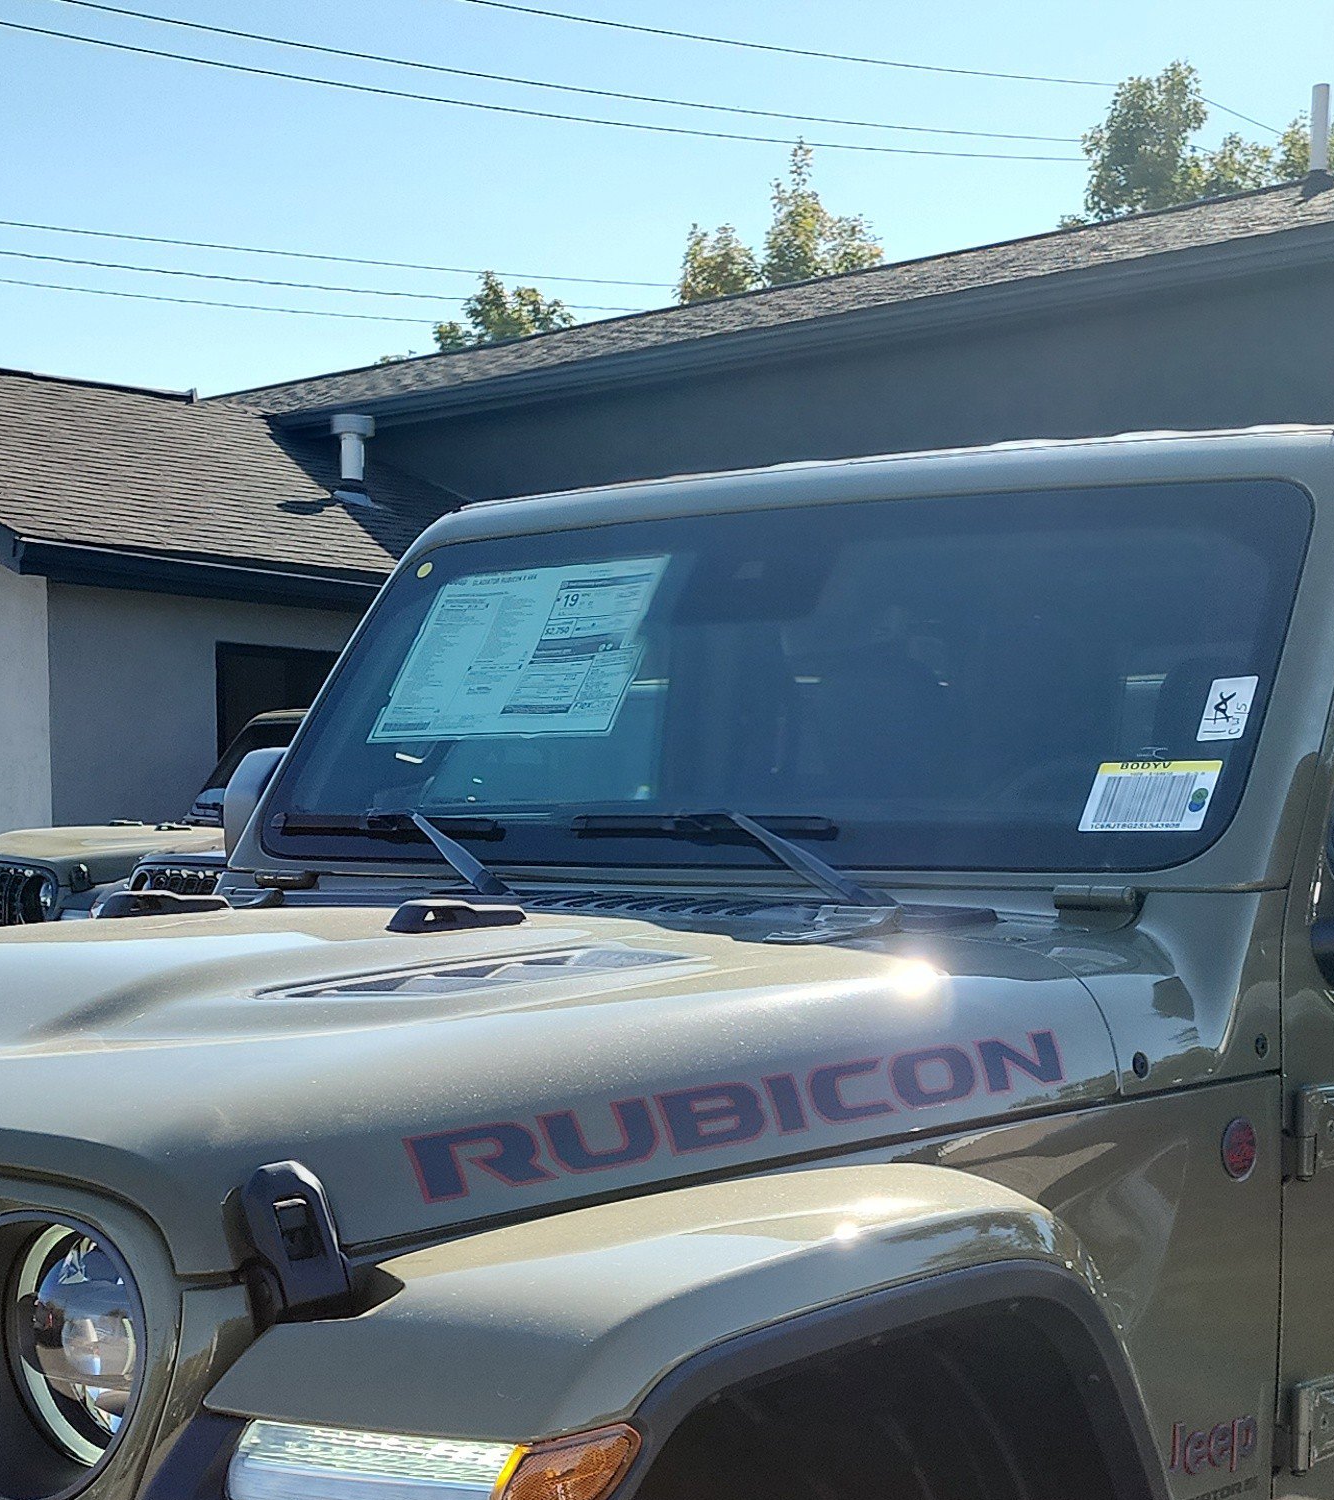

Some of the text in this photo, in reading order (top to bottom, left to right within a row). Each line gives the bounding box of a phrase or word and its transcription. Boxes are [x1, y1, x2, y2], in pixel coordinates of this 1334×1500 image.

[562, 593, 580, 608] 19
[404, 1029, 1067, 1204] RUBICON
[1169, 1415, 1257, 1476] Jeep
